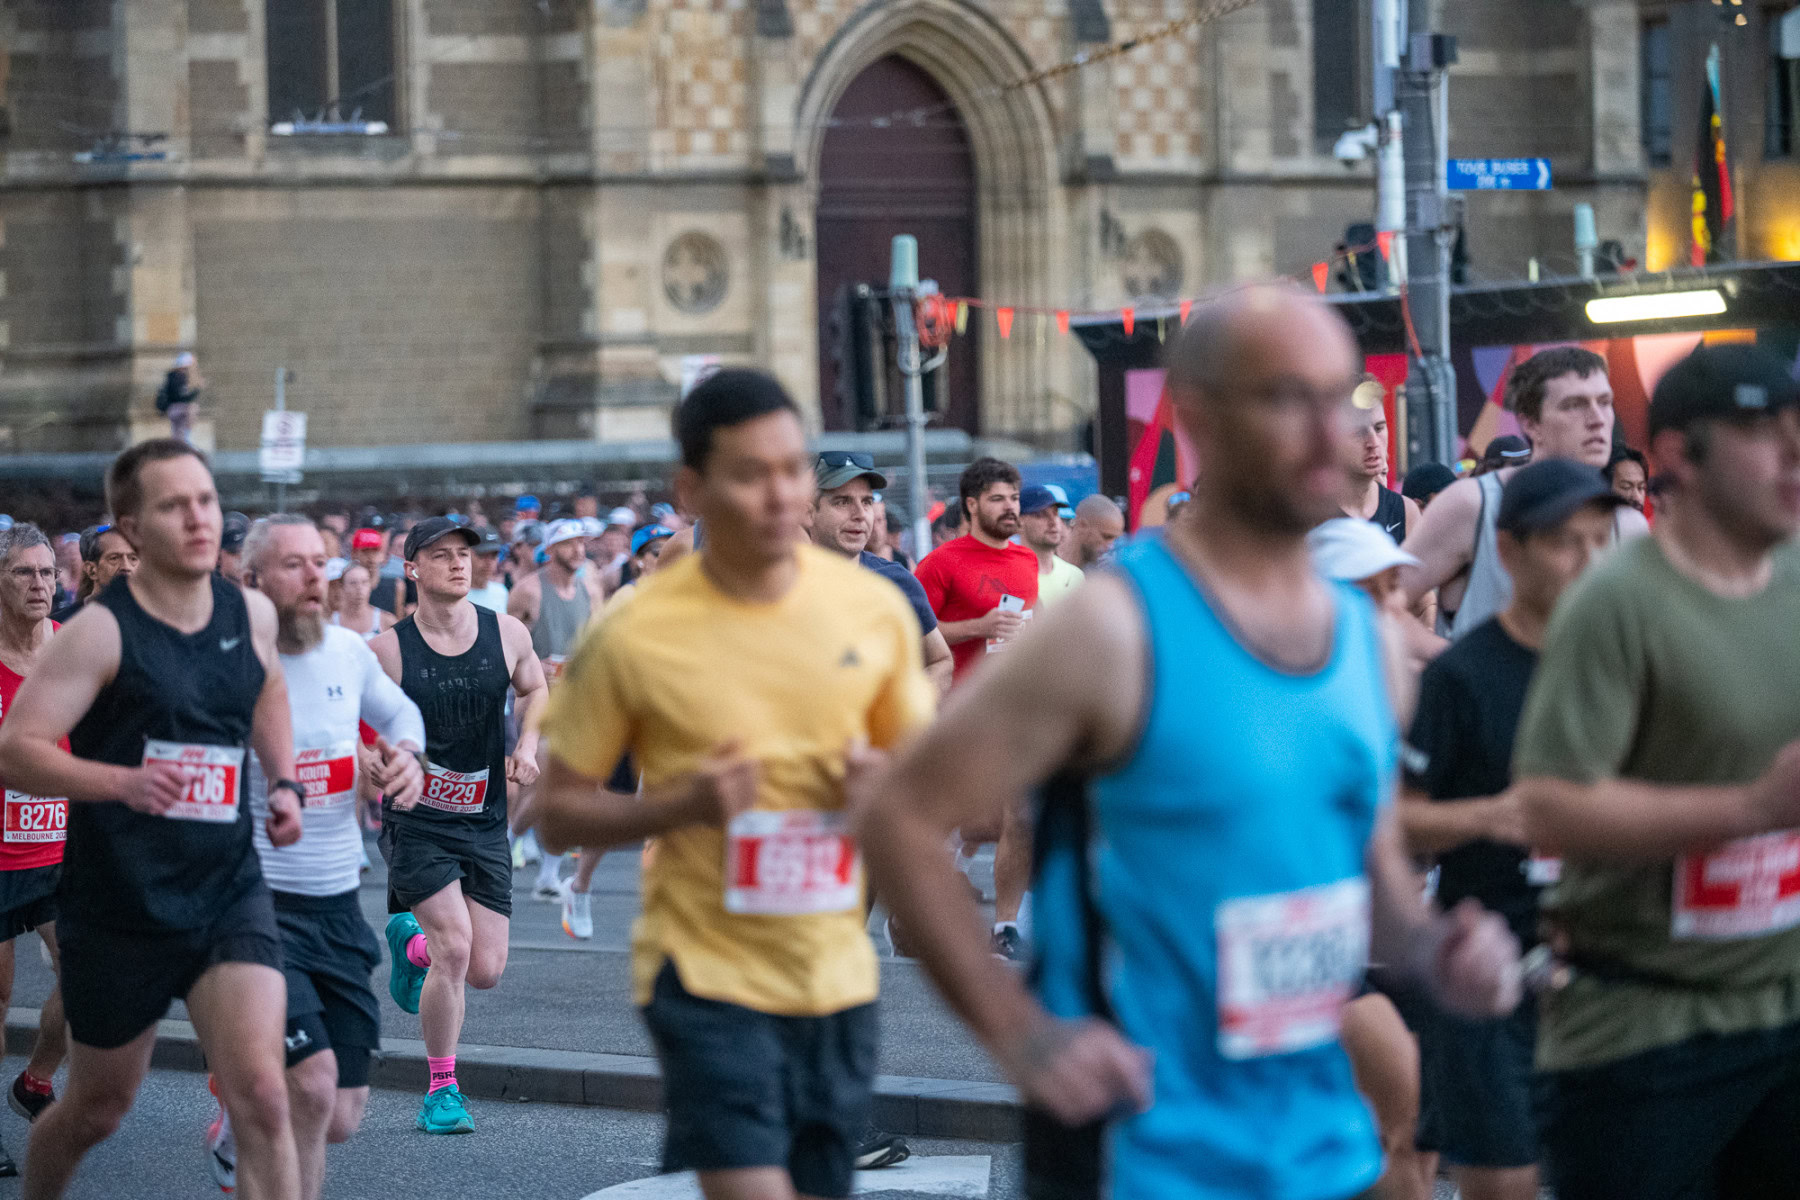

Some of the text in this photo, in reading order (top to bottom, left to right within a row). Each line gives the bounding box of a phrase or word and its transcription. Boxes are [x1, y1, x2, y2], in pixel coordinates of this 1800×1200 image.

[427, 778, 477, 804] 8229
[20, 803, 66, 830] 8276
[12, 832, 54, 841] MELBOURNE
